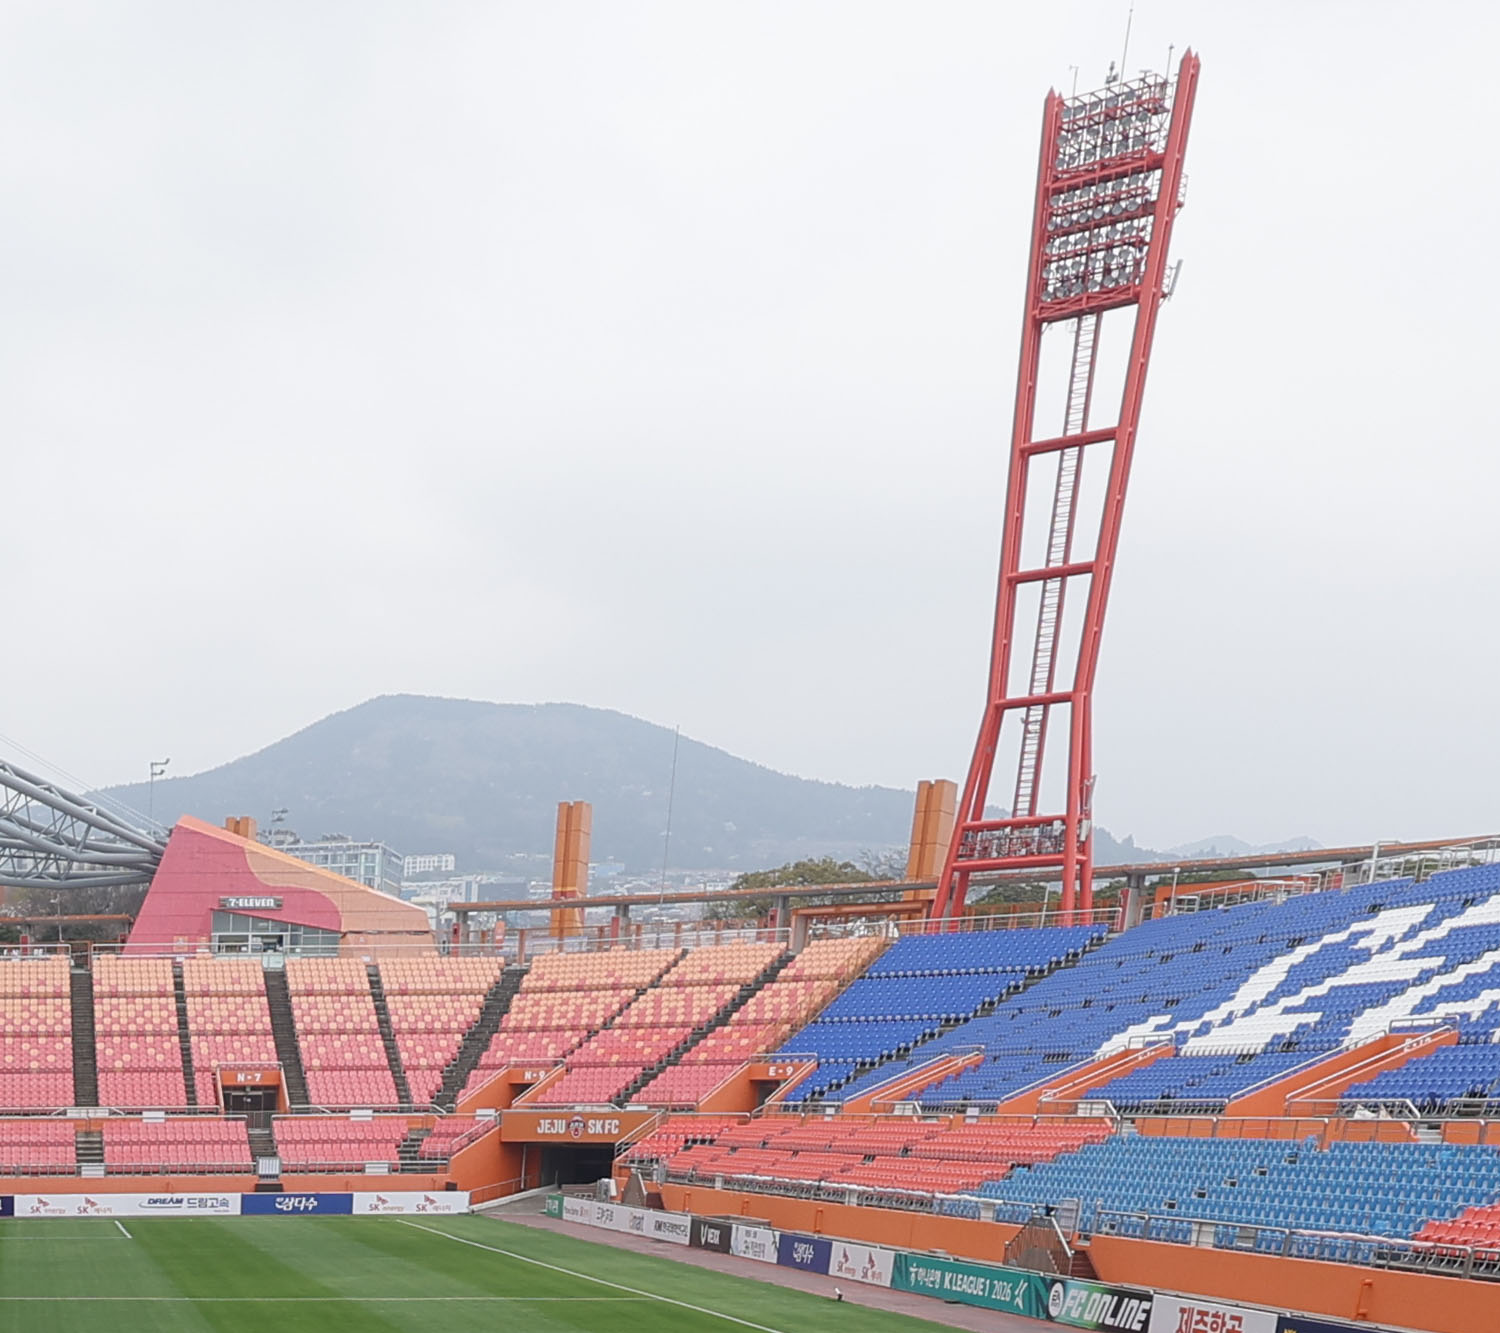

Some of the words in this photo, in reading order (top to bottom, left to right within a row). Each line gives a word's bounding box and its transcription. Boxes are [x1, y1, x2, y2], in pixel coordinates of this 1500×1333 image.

[230, 898, 274, 908] 7-ELEVEN
[537, 1119, 565, 1134] JEJU
[588, 1119, 603, 1134] SK
[604, 1119, 619, 1134] FC
[187, 1197, 230, 1209] 드림고속
[369, 1203, 380, 1211] SK
[416, 1203, 427, 1212] SK
[30, 1206, 41, 1214] SK
[77, 1206, 89, 1215] SK
[917, 1269, 941, 1289] 하나은행
[943, 1273, 952, 1289] K
[991, 1281, 1012, 1301] 2026
[1062, 1289, 1082, 1317] FC
[1085, 1292, 1151, 1331] ONLINE
